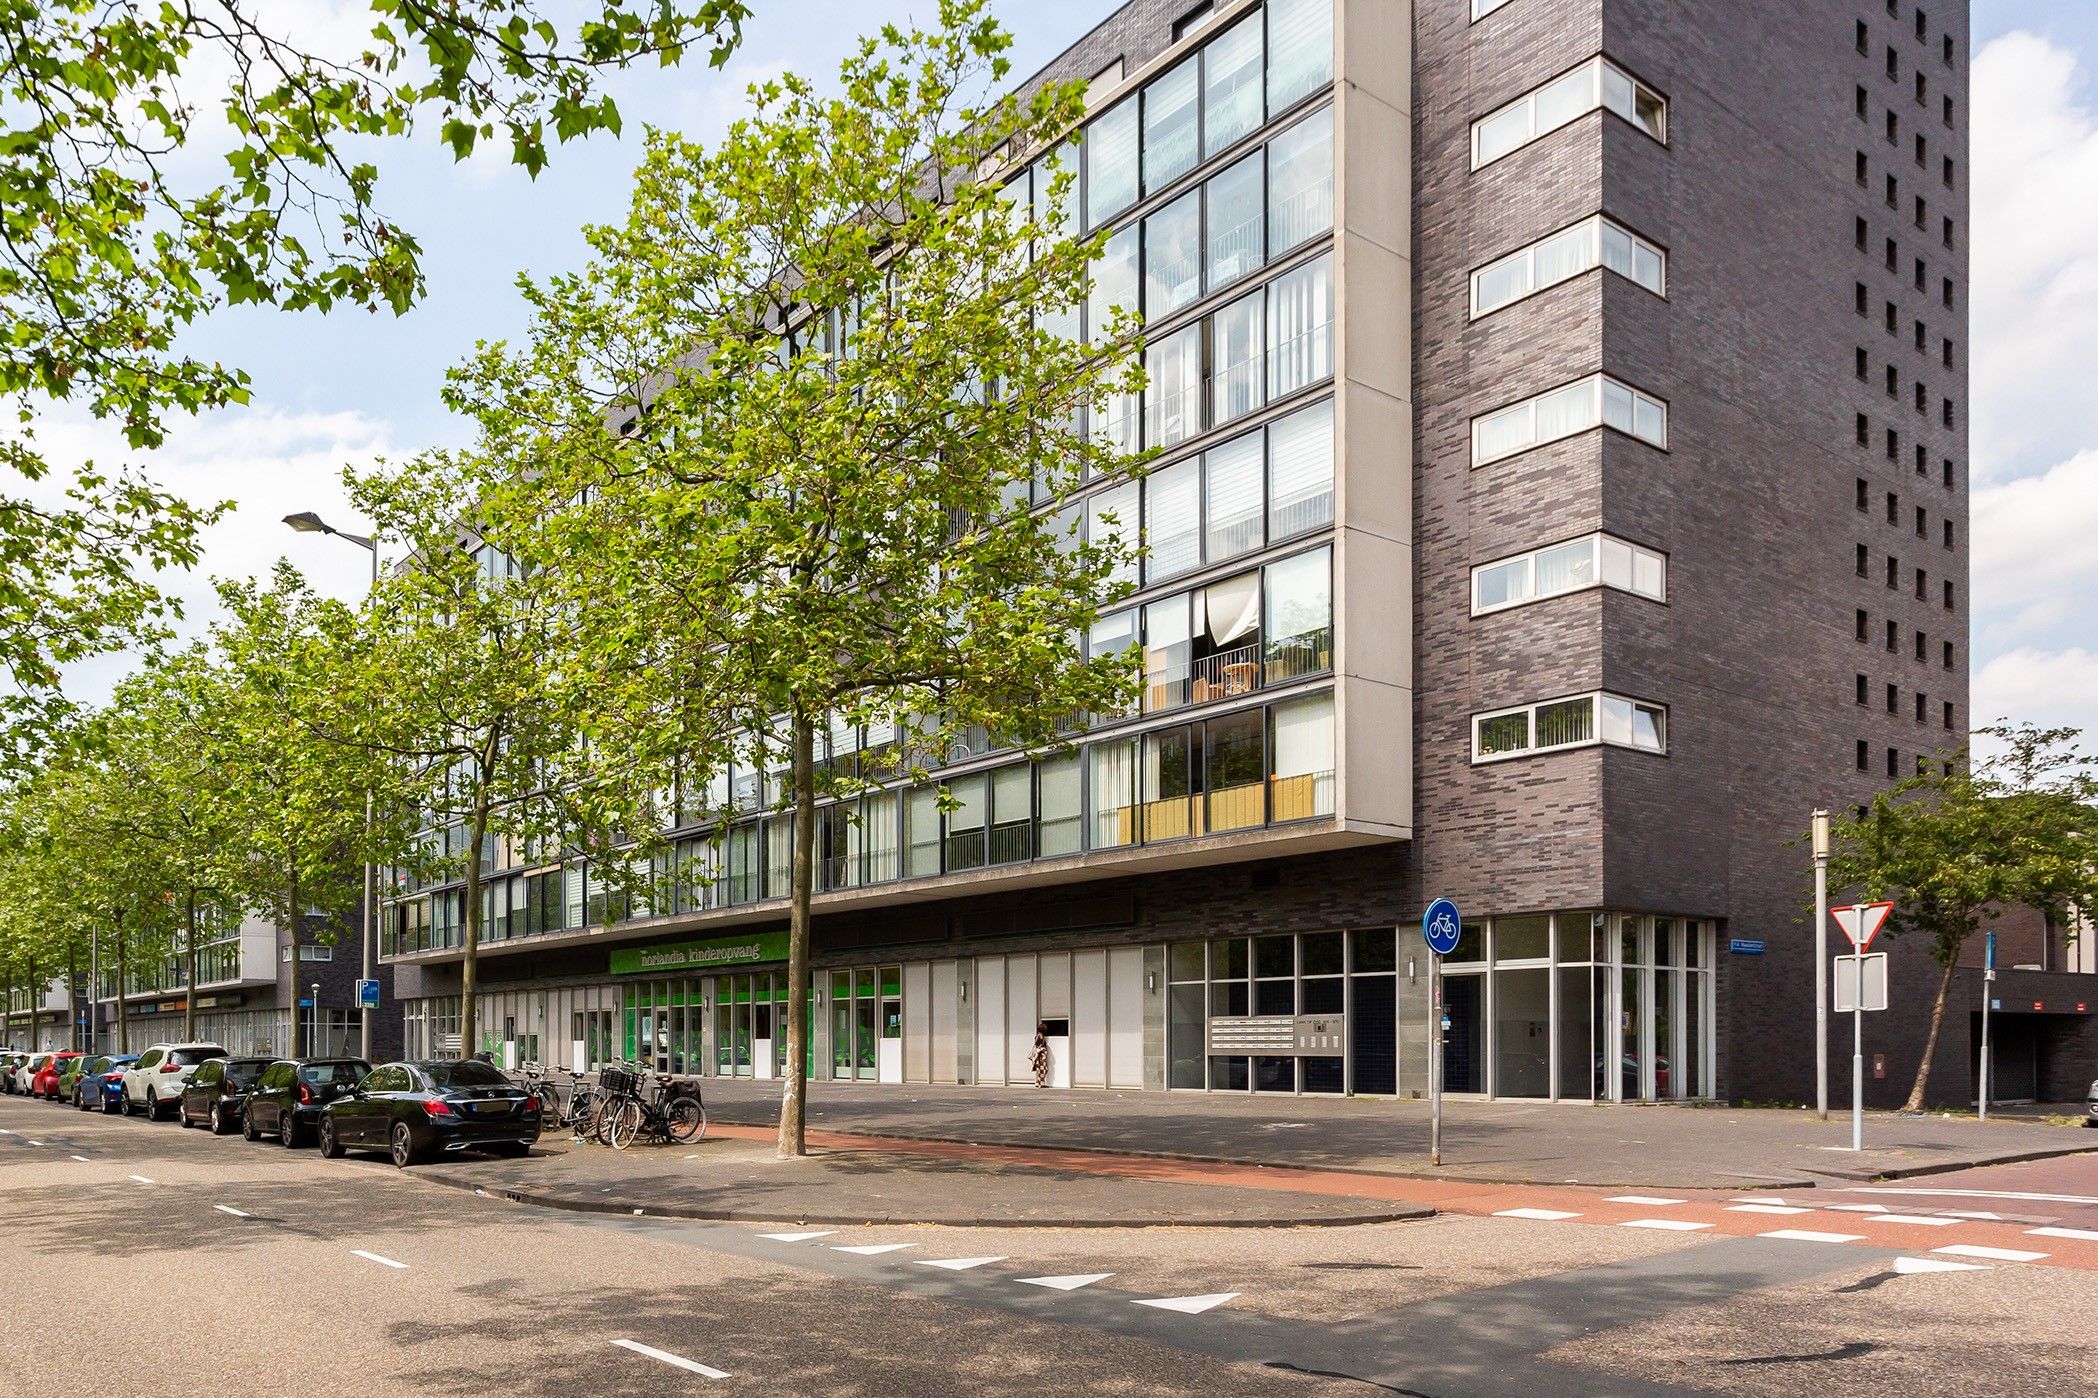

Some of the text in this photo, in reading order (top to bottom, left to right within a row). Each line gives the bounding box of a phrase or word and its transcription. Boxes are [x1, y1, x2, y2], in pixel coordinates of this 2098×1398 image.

[641, 943, 761, 966] norlandia kinderopvang
[362, 981, 369, 990] P
